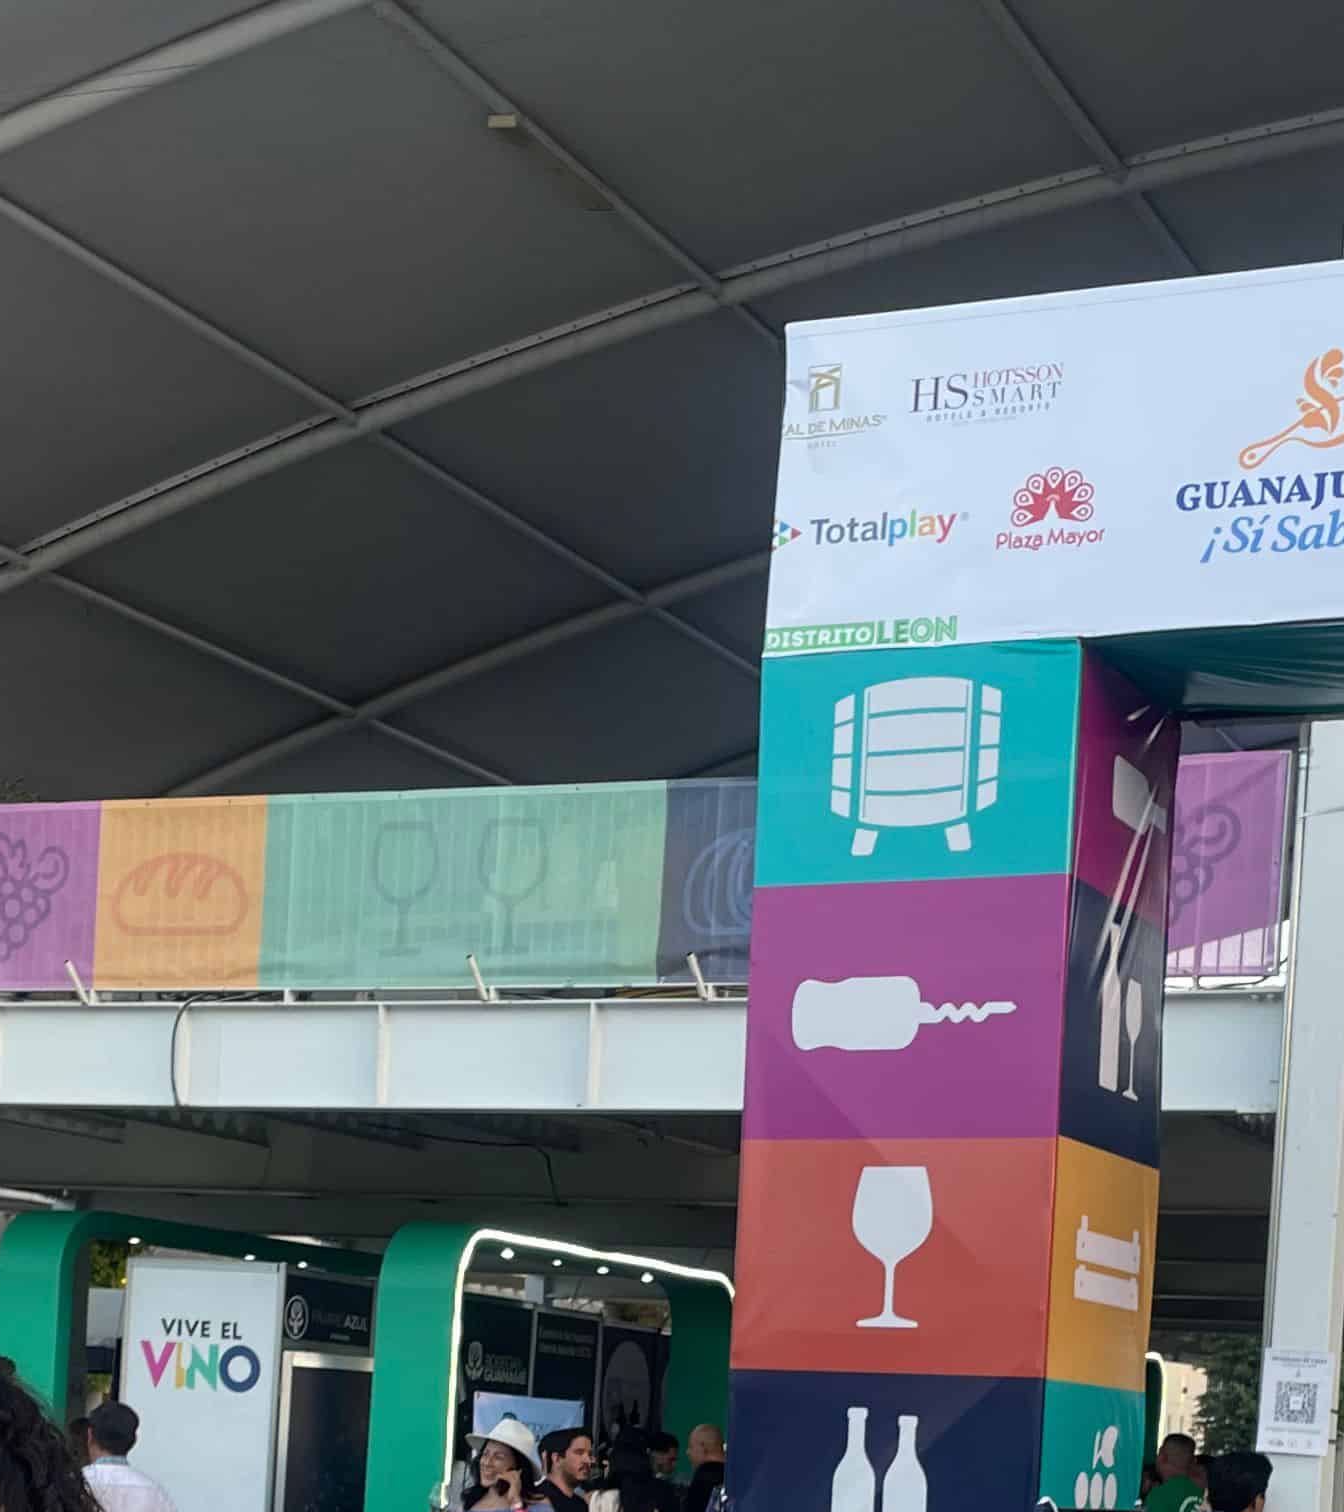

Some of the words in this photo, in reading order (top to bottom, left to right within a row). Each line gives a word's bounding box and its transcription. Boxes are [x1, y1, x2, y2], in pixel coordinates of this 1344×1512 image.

[973, 362, 1064, 389] HOTSSON
[908, 373, 968, 413] HS
[972, 381, 1062, 408] SMART
[783, 422, 806, 436] AL
[807, 421, 827, 435] DE
[828, 414, 883, 432] MINAS
[810, 509, 956, 546] Totalplay
[995, 530, 1044, 550] Plaza
[1046, 526, 1105, 547] Mayor
[1200, 514, 1270, 563] ¡Sí
[161, 1318, 210, 1338] VIVE
[221, 1321, 242, 1340] EL
[141, 1340, 261, 1393] VINO
